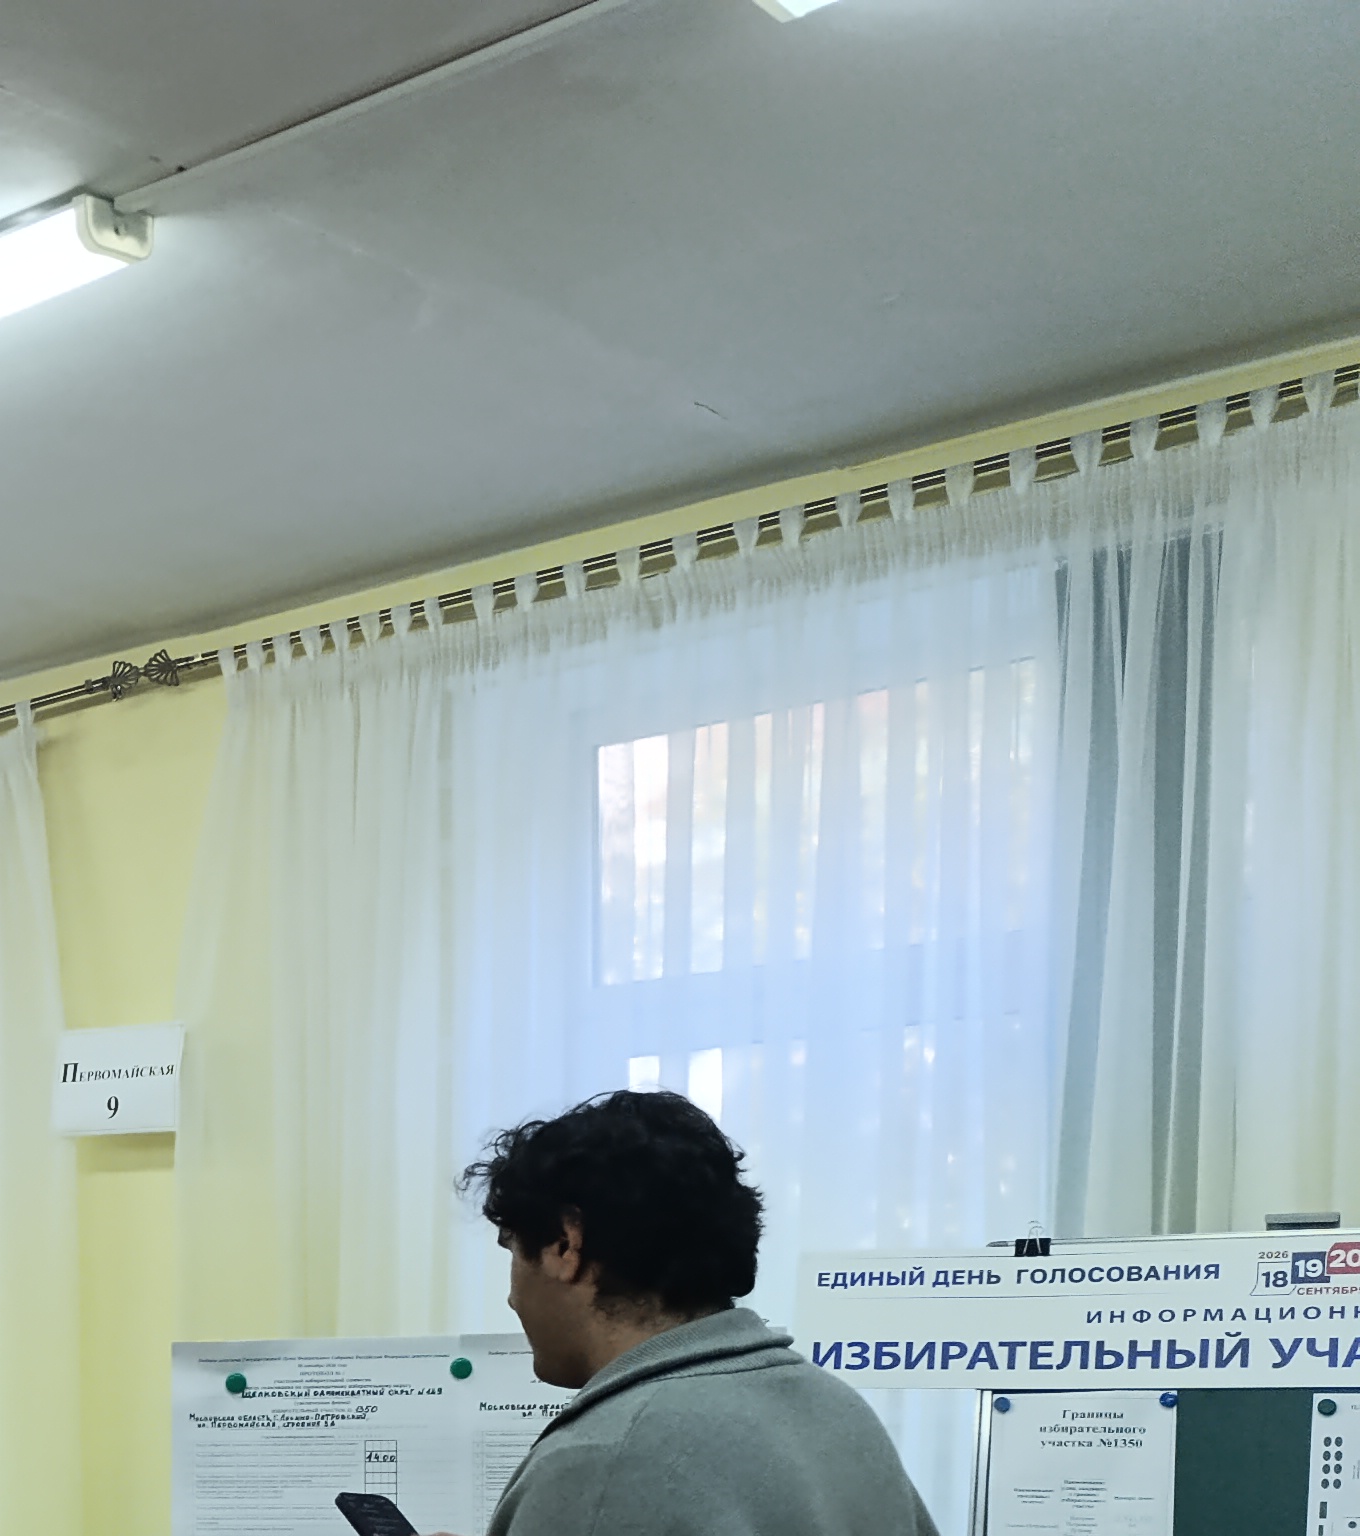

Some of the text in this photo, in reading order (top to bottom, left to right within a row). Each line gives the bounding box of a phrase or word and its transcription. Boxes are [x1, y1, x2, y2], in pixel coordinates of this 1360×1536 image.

[106, 1095, 119, 1119] 9
[1258, 1250, 1289, 1259] 2026
[816, 1263, 1220, 1290] ЕДИНЫЙ ДЕНЬ ГОЛОСОВАНИЯ
[1261, 1248, 1360, 1288] 18 19 20
[812, 1331, 1250, 1371] ИЗБИРАТЕЛЬНЫЙ
[1062, 1409, 1124, 1421] Границы
[1039, 1424, 1147, 1436] избирательного
[1040, 1438, 1144, 1450] участка №1350
